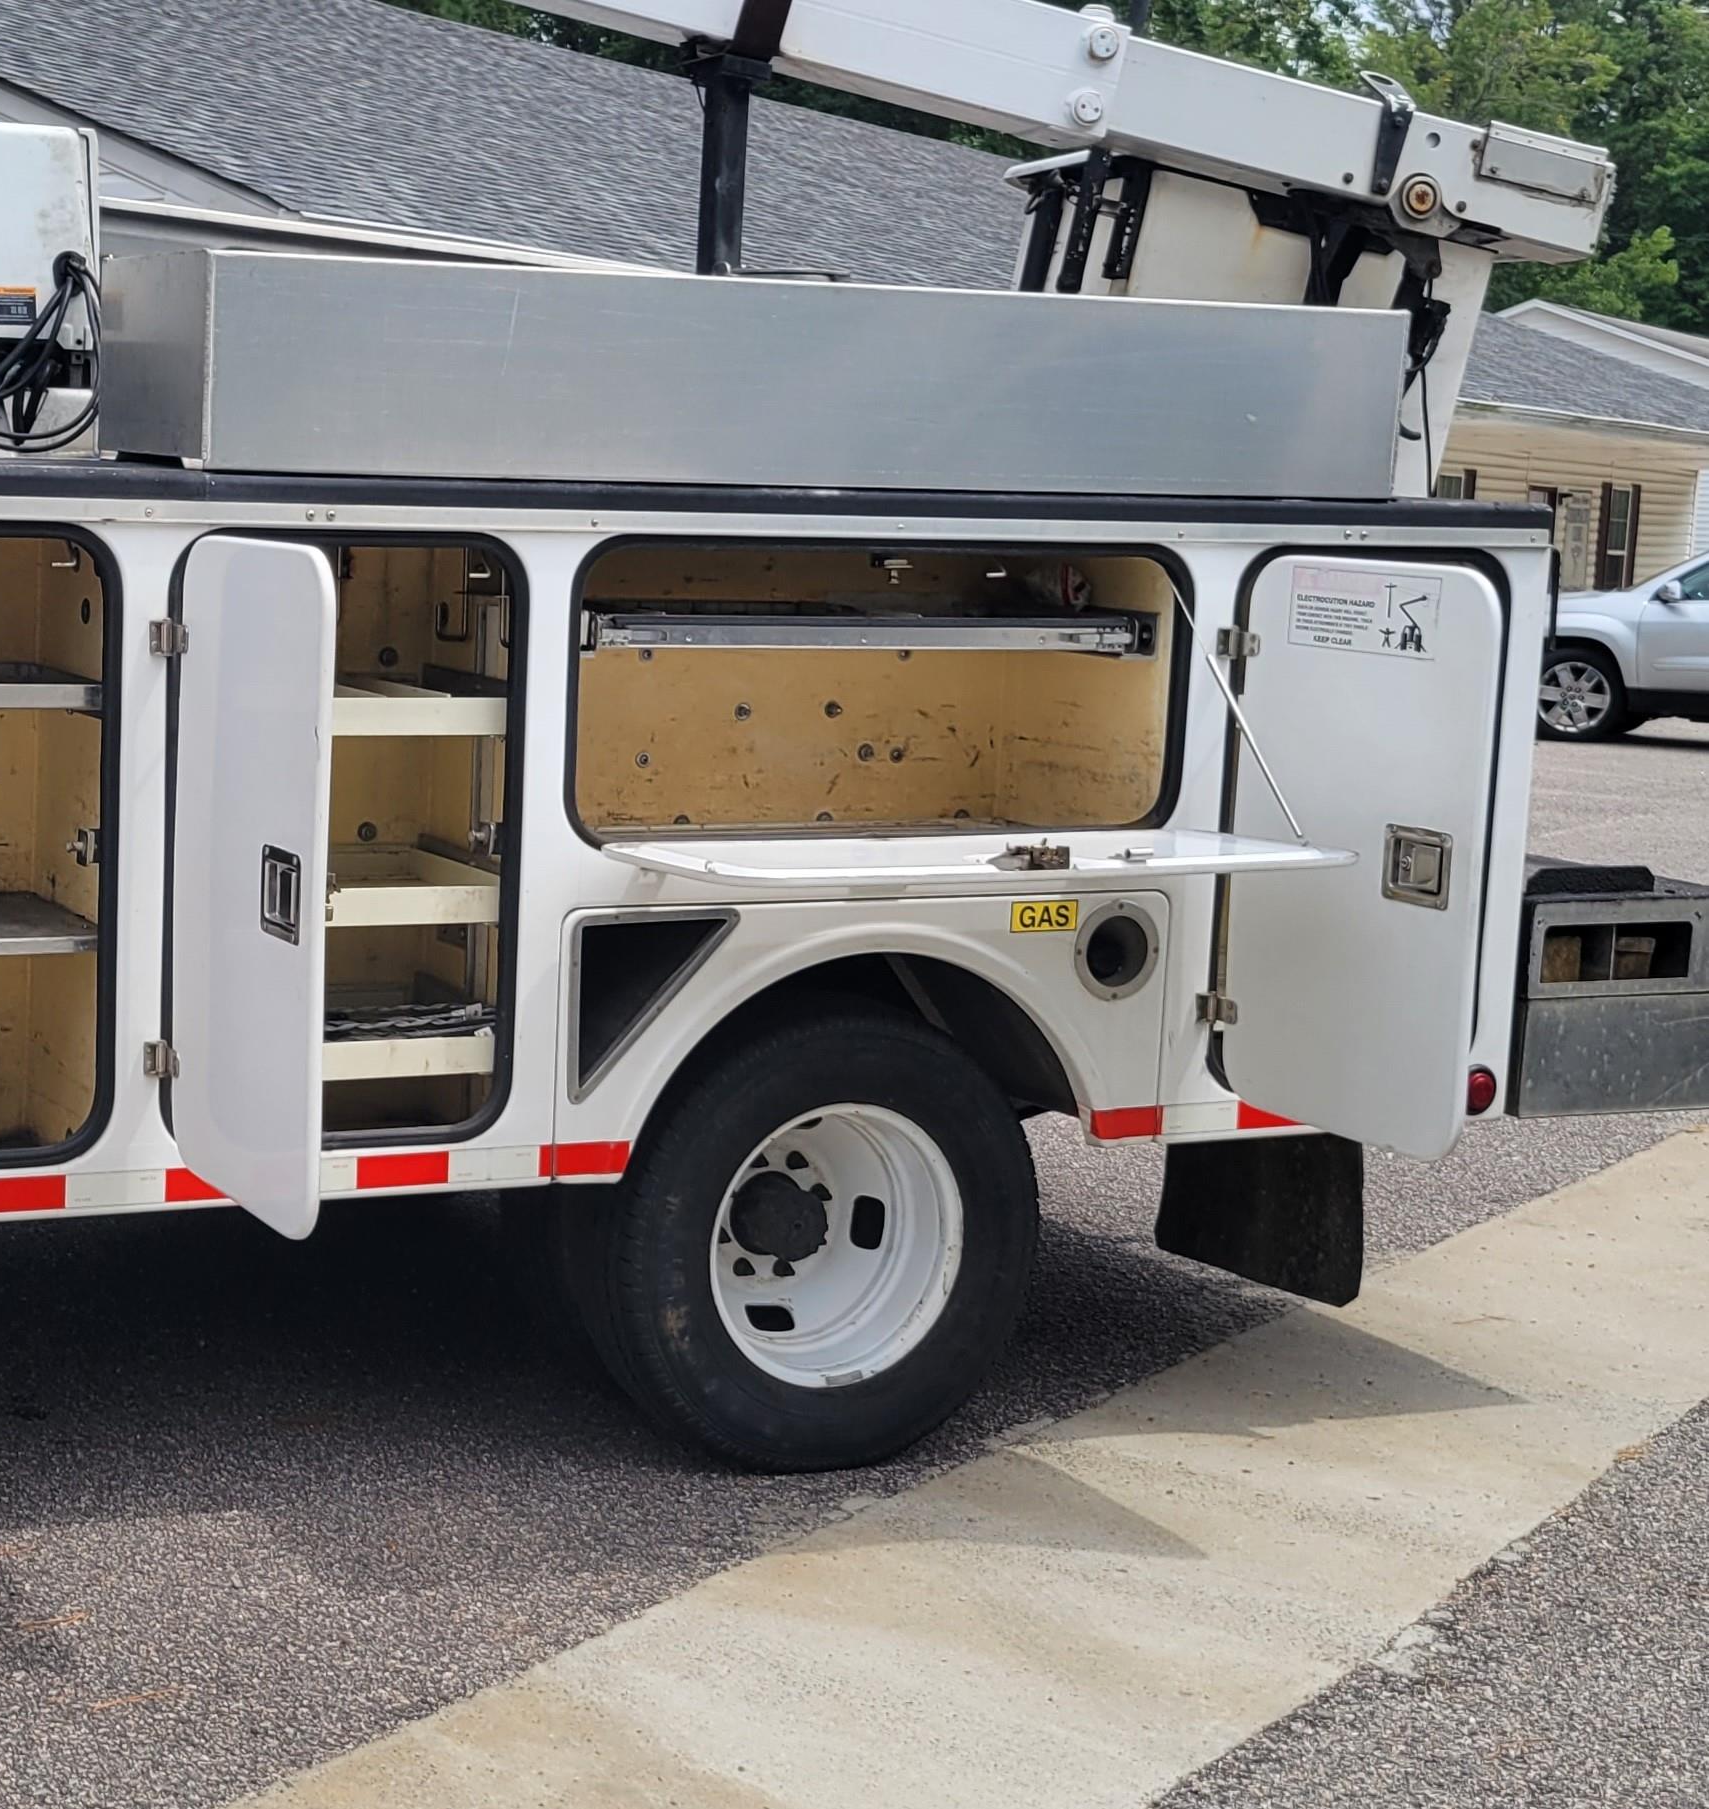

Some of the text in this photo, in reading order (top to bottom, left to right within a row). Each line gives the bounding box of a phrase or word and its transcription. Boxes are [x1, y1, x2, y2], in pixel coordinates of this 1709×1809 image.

[1297, 594, 1376, 608] ELECTROCUTION HAZARD
[1313, 635, 1352, 646] KEEP CLEAR
[1019, 904, 1070, 929] GAS
